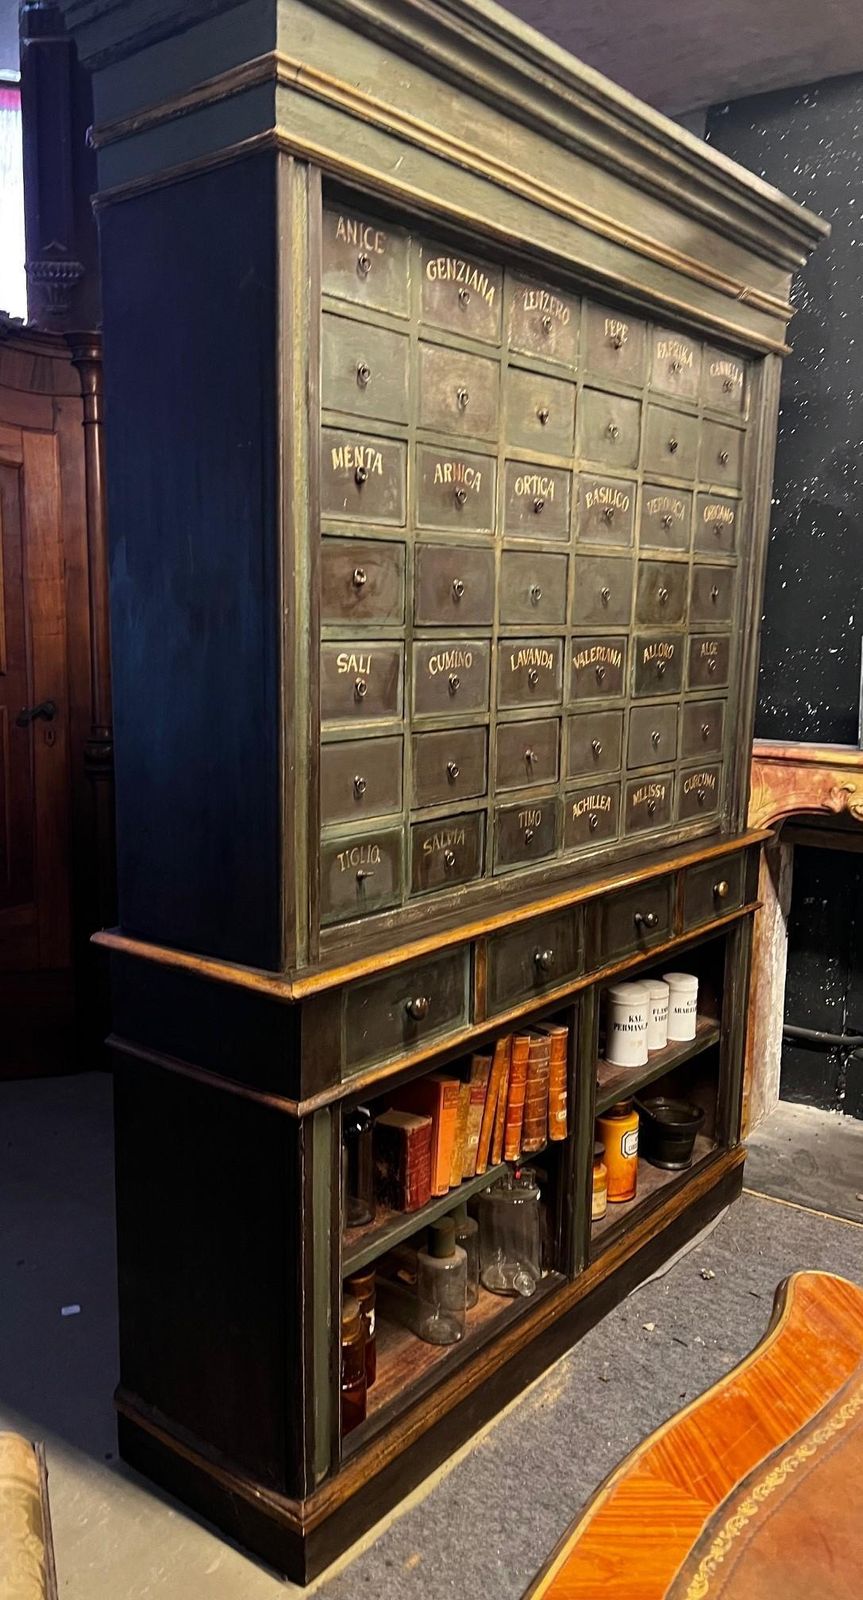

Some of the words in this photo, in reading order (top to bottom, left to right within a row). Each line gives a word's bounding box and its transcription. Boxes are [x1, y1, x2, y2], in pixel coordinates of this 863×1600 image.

[336, 216, 386, 254] ANICE
[426, 257, 495, 307] GENZIANA
[331, 446, 383, 475] MENTA
[433, 462, 482, 493] ARNICA
[514, 474, 555, 501] ORTICA
[585, 486, 630, 512] BASILICO
[336, 653, 372, 675] SALI
[428, 650, 473, 675] CUMINO
[510, 648, 554, 671] LAVANDA
[572, 646, 622, 670] VALERIANA
[643, 642, 675, 664] ALLORO
[518, 809, 542, 828] TIMO
[572, 793, 612, 821] ACHILLEA
[423, 829, 466, 857] SALVIA
